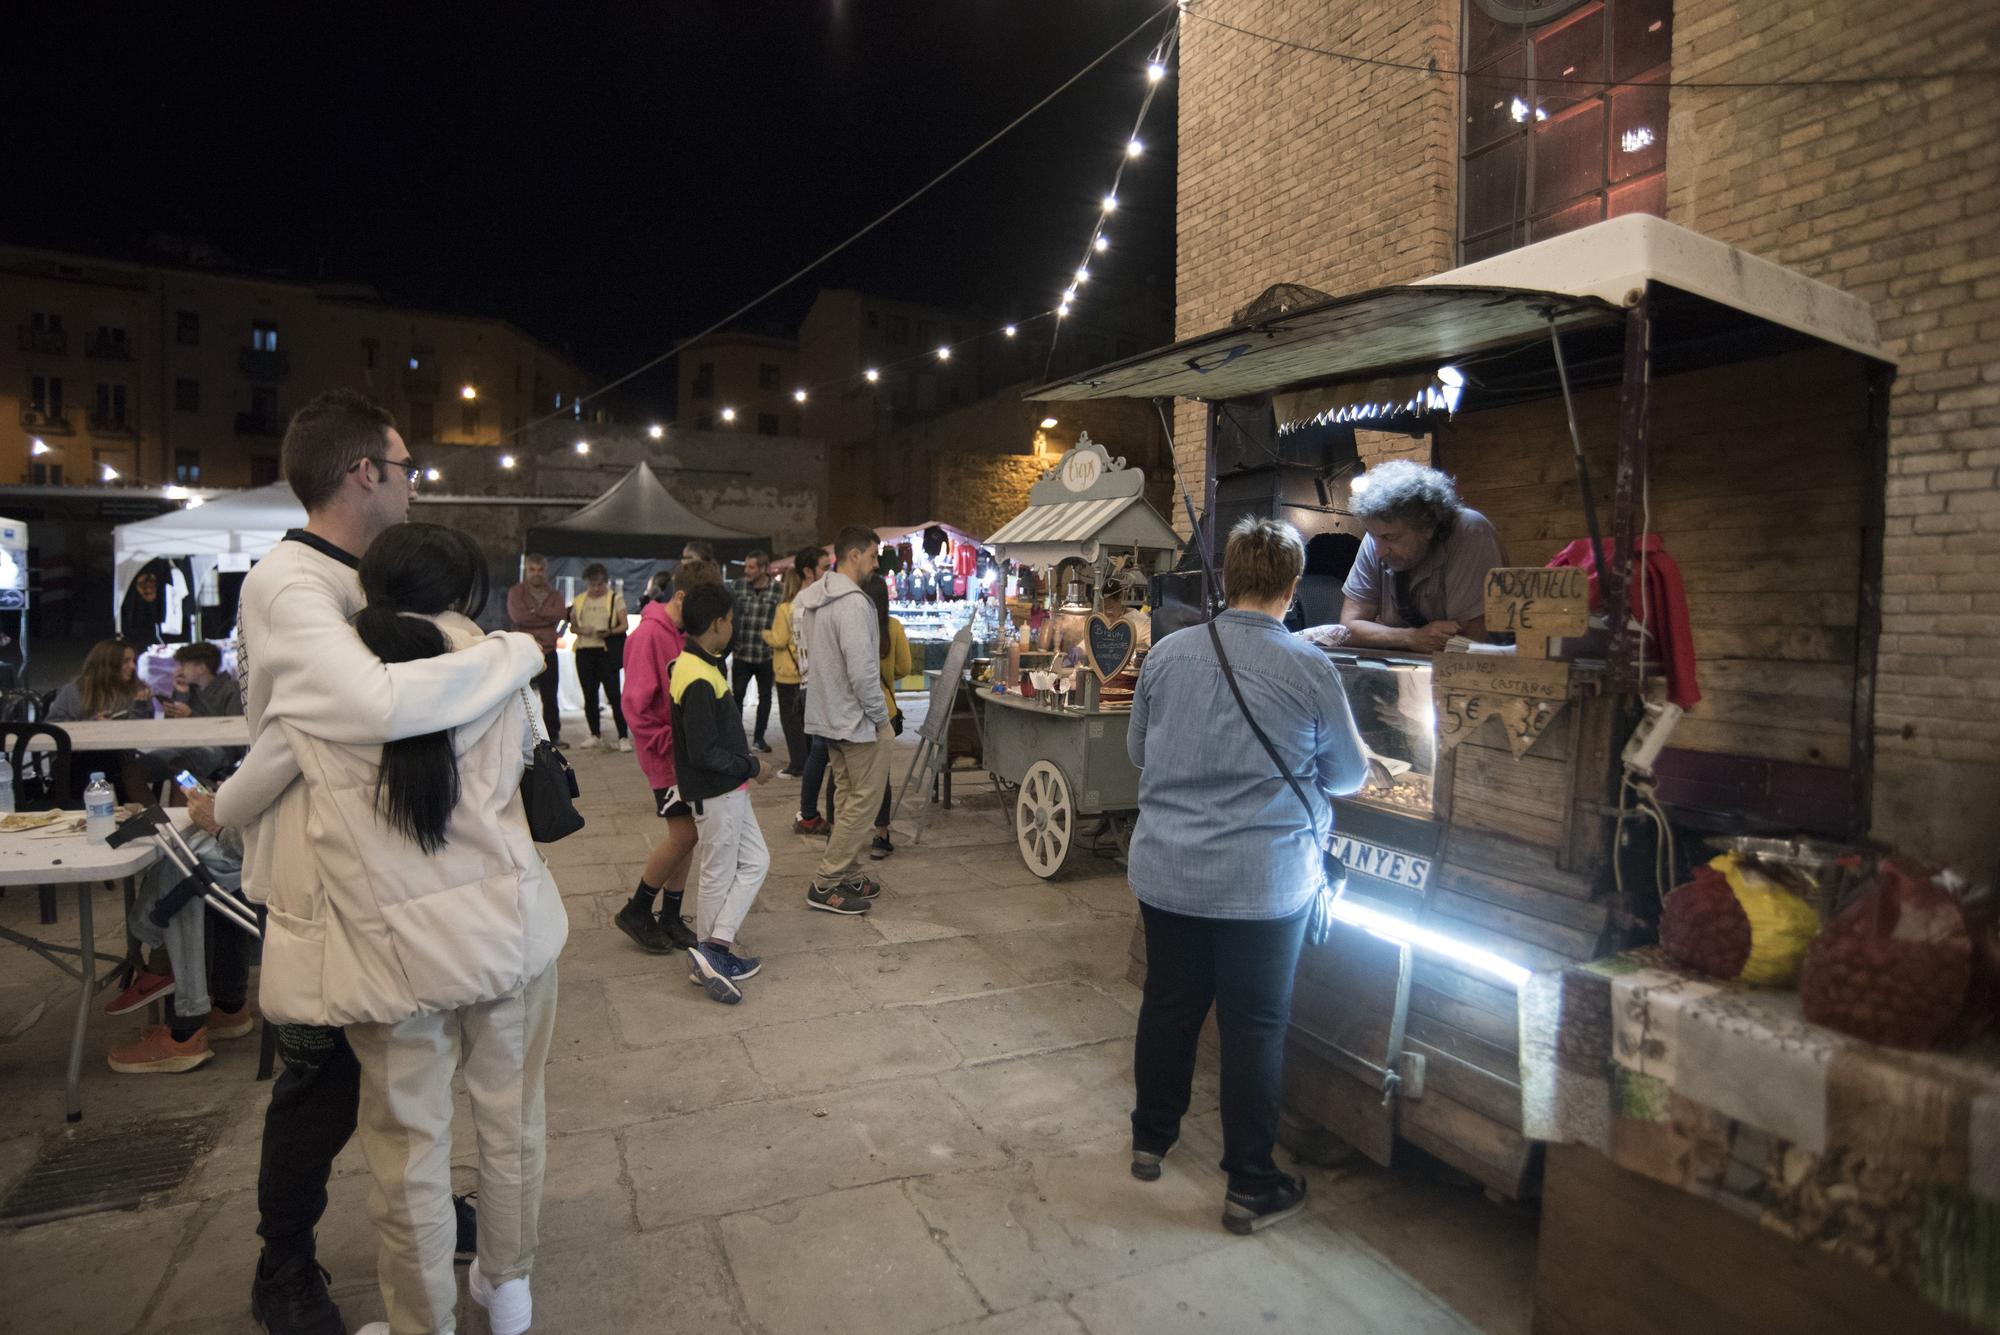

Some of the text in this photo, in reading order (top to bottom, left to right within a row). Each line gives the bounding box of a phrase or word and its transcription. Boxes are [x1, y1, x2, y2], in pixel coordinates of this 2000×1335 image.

[1506, 601, 1535, 628] 1€
[1443, 694, 1480, 734] 5€
[1517, 698, 1552, 738] 3€
